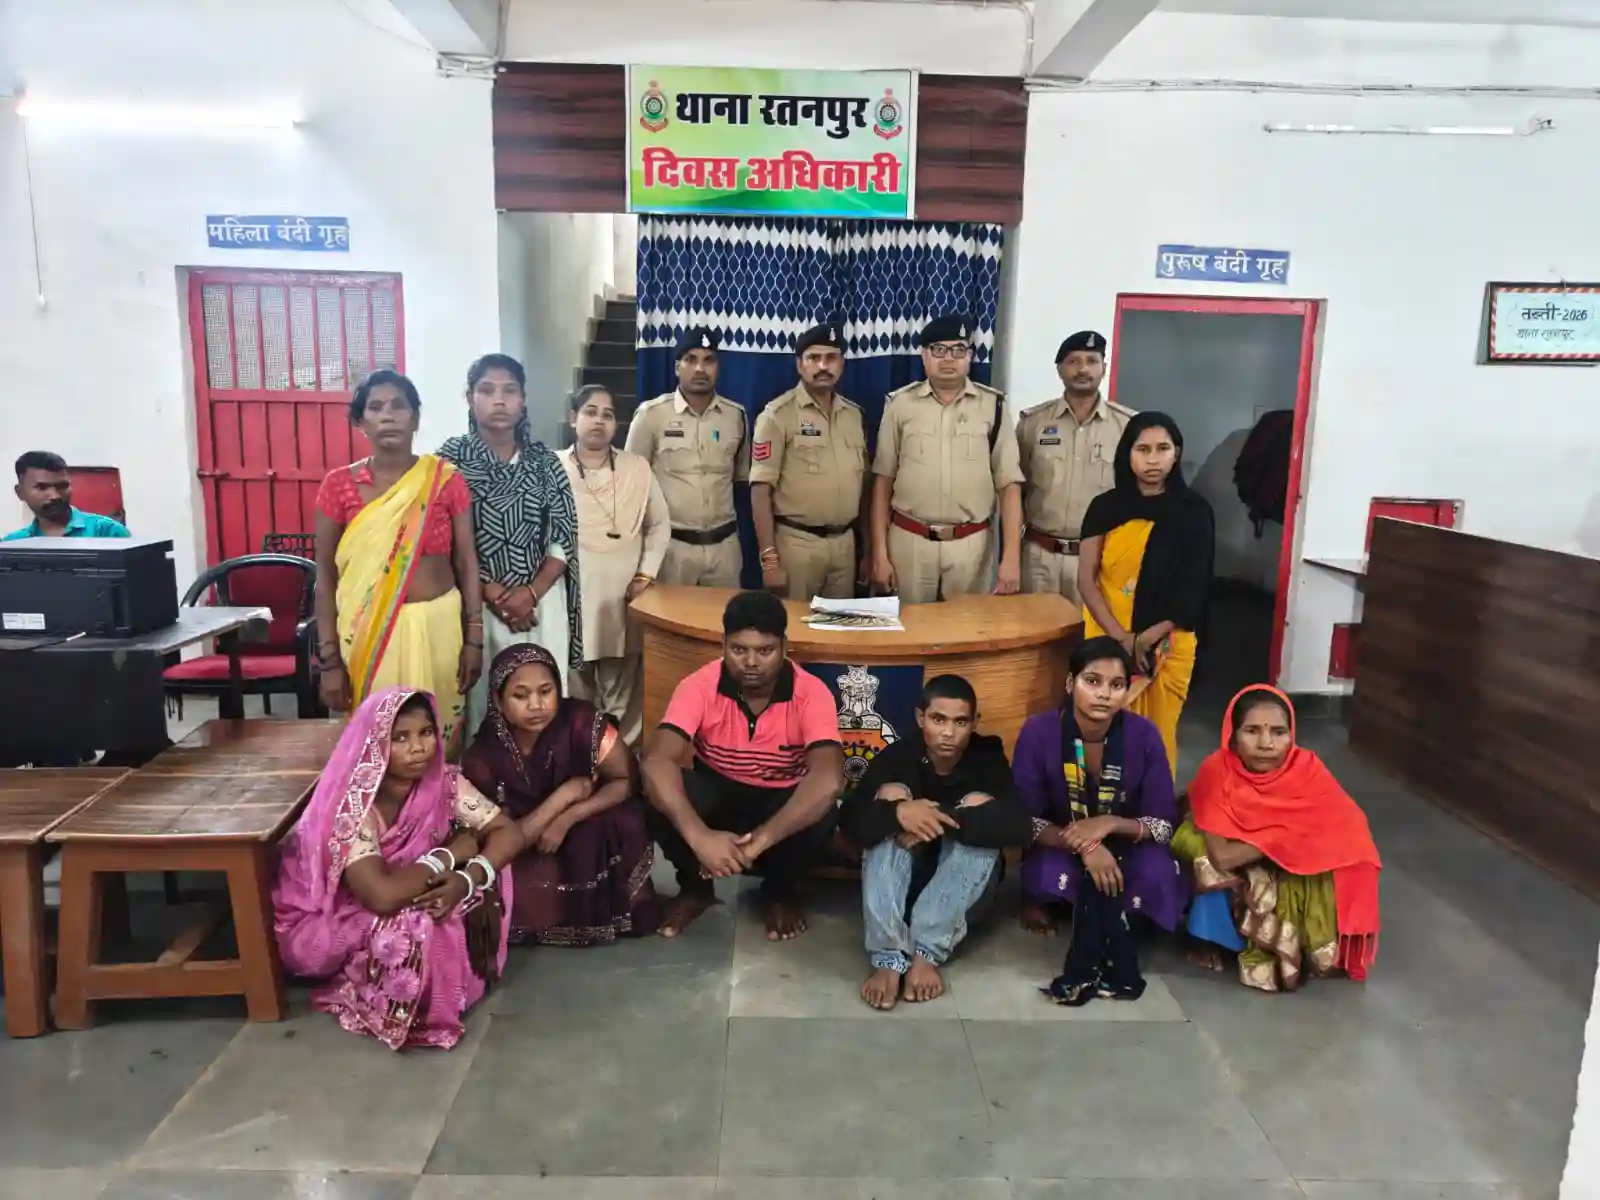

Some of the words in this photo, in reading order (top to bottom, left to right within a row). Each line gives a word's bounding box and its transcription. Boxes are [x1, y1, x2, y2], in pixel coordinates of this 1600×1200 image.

[676, 93, 752, 124] थाना
[758, 95, 870, 139] रतनपुर
[641, 147, 741, 189] दिवस
[746, 150, 903, 193] अधिकारी
[208, 217, 270, 244] महिला
[276, 218, 312, 243] बंदी
[318, 225, 348, 248] गृह
[1213, 250, 1251, 274] बंदी
[1256, 257, 1287, 281] गृह
